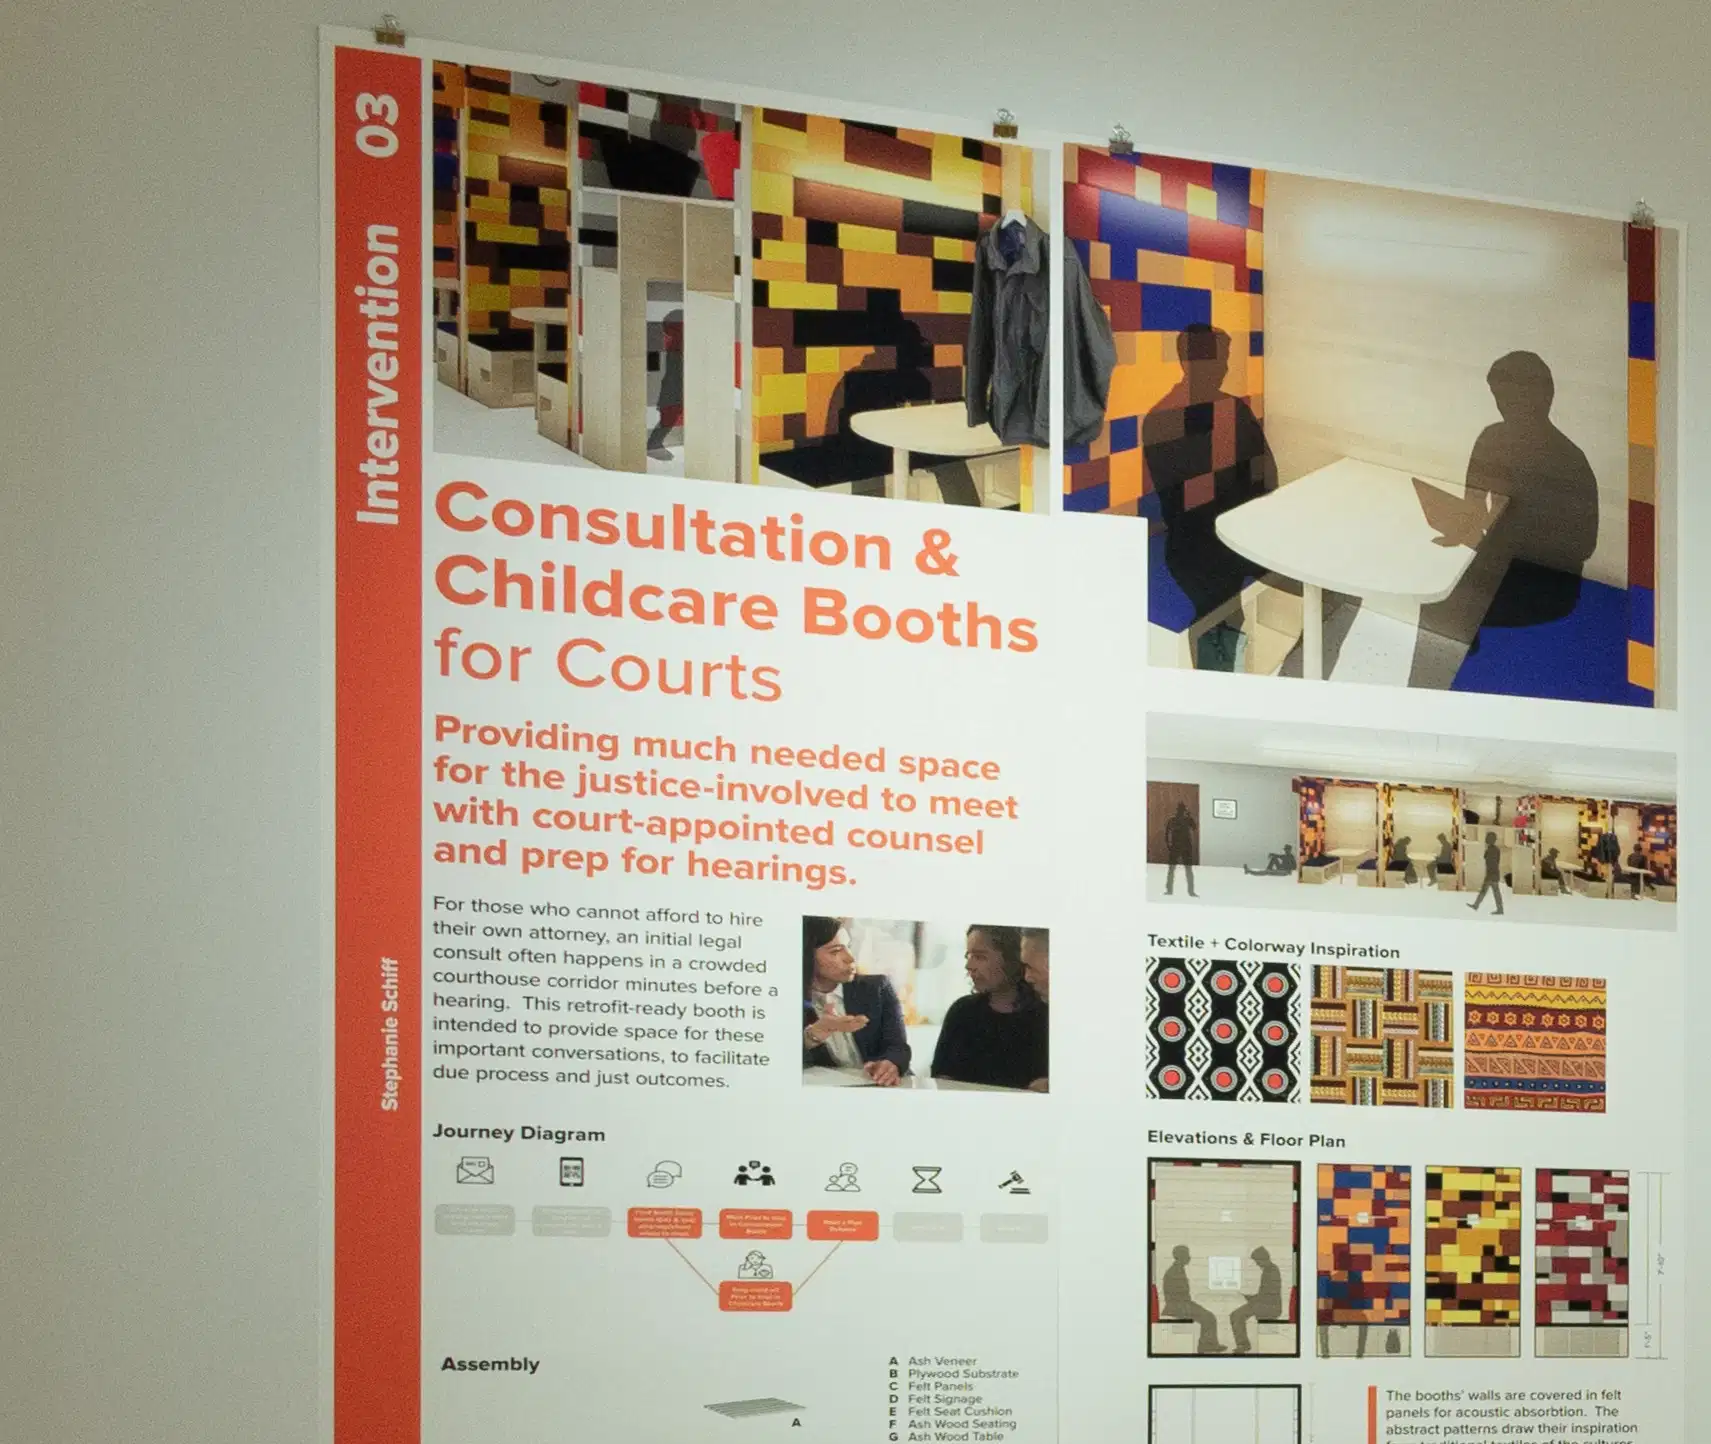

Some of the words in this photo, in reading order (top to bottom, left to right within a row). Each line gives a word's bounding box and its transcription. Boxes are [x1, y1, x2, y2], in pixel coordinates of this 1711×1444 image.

[354, 92, 399, 159] 03
[354, 224, 401, 528] Intervention
[434, 480, 891, 570] Consultation
[915, 528, 958, 576] &
[434, 554, 778, 630] Childcare
[804, 586, 1038, 652] Booths
[434, 626, 532, 683] for
[556, 637, 781, 702] Courts
[434, 713, 619, 761] Providing
[634, 735, 736, 762] much
[751, 744, 885, 772] needed
[899, 755, 1000, 782] space
[432, 754, 490, 785] for
[500, 760, 565, 790] the
[572, 763, 867, 809] justice-involved
[881, 787, 916, 812] to
[930, 795, 1017, 819] meet
[432, 795, 519, 827] with
[532, 807, 833, 845] court-appointed
[847, 828, 983, 854] counsel
[433, 838, 507, 866] and
[521, 847, 609, 878] prep
[621, 846, 674, 875] for
[688, 850, 856, 890] hearings.
[433, 895, 465, 912] For
[470, 898, 524, 915] those
[529, 901, 570, 917] who
[576, 907, 639, 920] cannot
[646, 907, 699, 923] afford
[706, 911, 723, 924] to
[730, 912, 763, 927] hire
[1147, 933, 1205, 949] Textile
[1211, 939, 1218, 947] +
[1224, 937, 1305, 957] Colorway
[1311, 941, 1400, 959] Inspiration
[381, 957, 402, 1011] Schiff
[381, 1016, 403, 1111] Stephanie
[432, 1123, 514, 1143] Journey
[521, 1125, 605, 1144] Diagram
[1147, 1129, 1238, 1145] Elevations
[1243, 1132, 1254, 1145] &
[1260, 1132, 1303, 1146] Floor
[1309, 1134, 1345, 1148] Plan
[440, 1356, 540, 1375] Assembly
